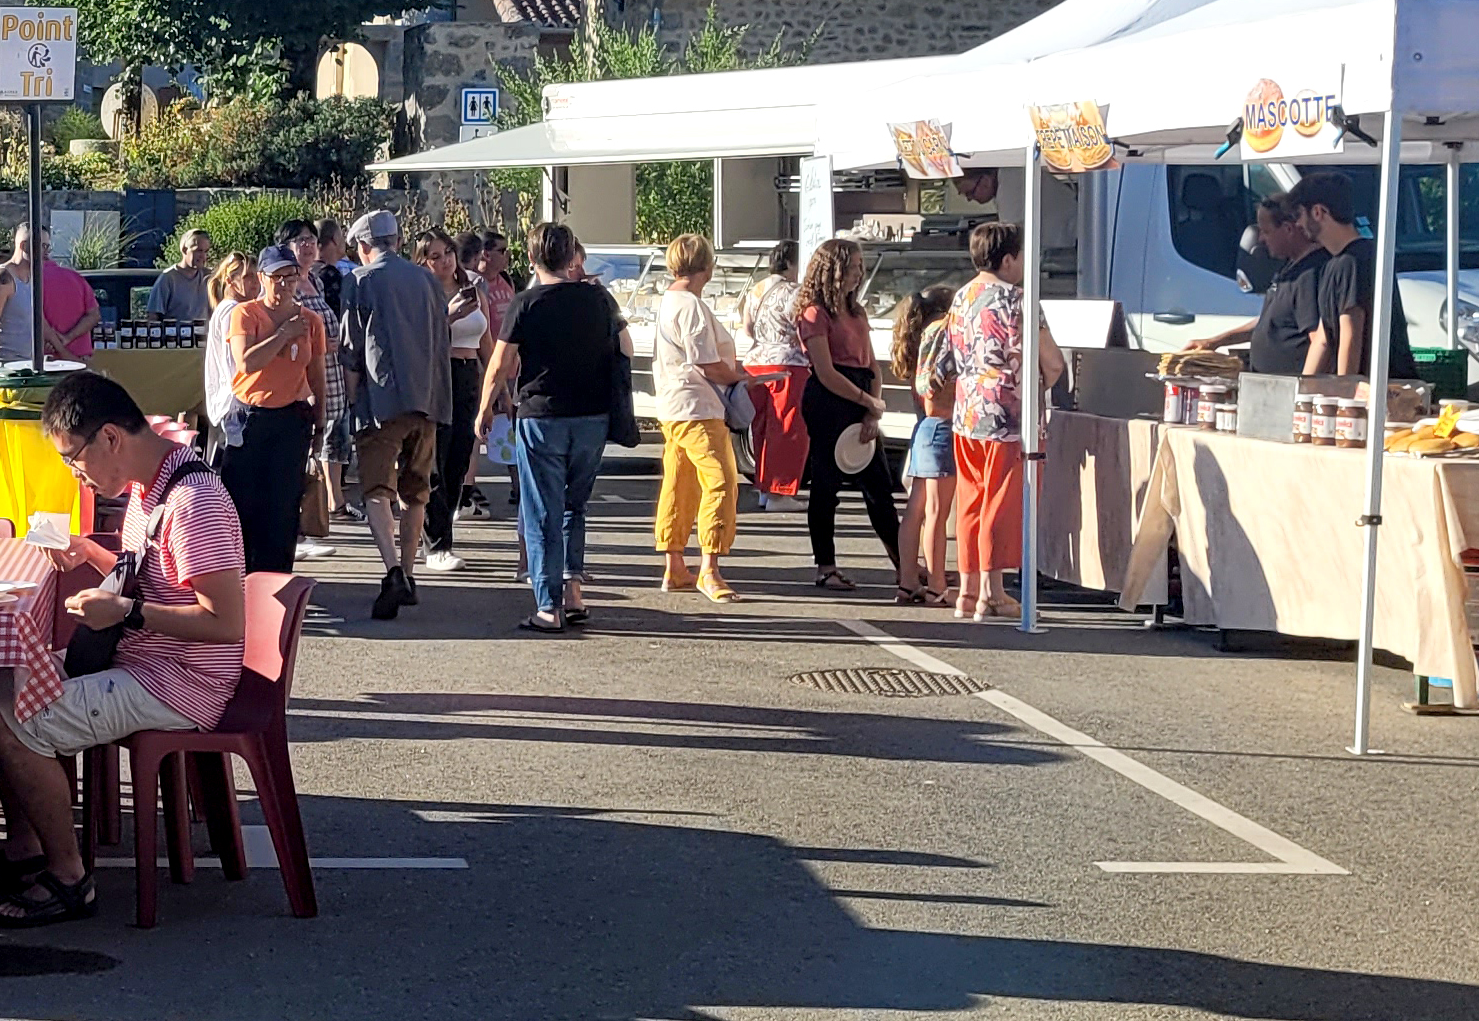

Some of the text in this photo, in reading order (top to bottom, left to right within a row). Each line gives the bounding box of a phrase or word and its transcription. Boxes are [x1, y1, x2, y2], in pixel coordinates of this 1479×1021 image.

[1, 11, 73, 42] Point
[20, 67, 53, 97] Tri
[1245, 94, 1336, 130] MASCOTTE
